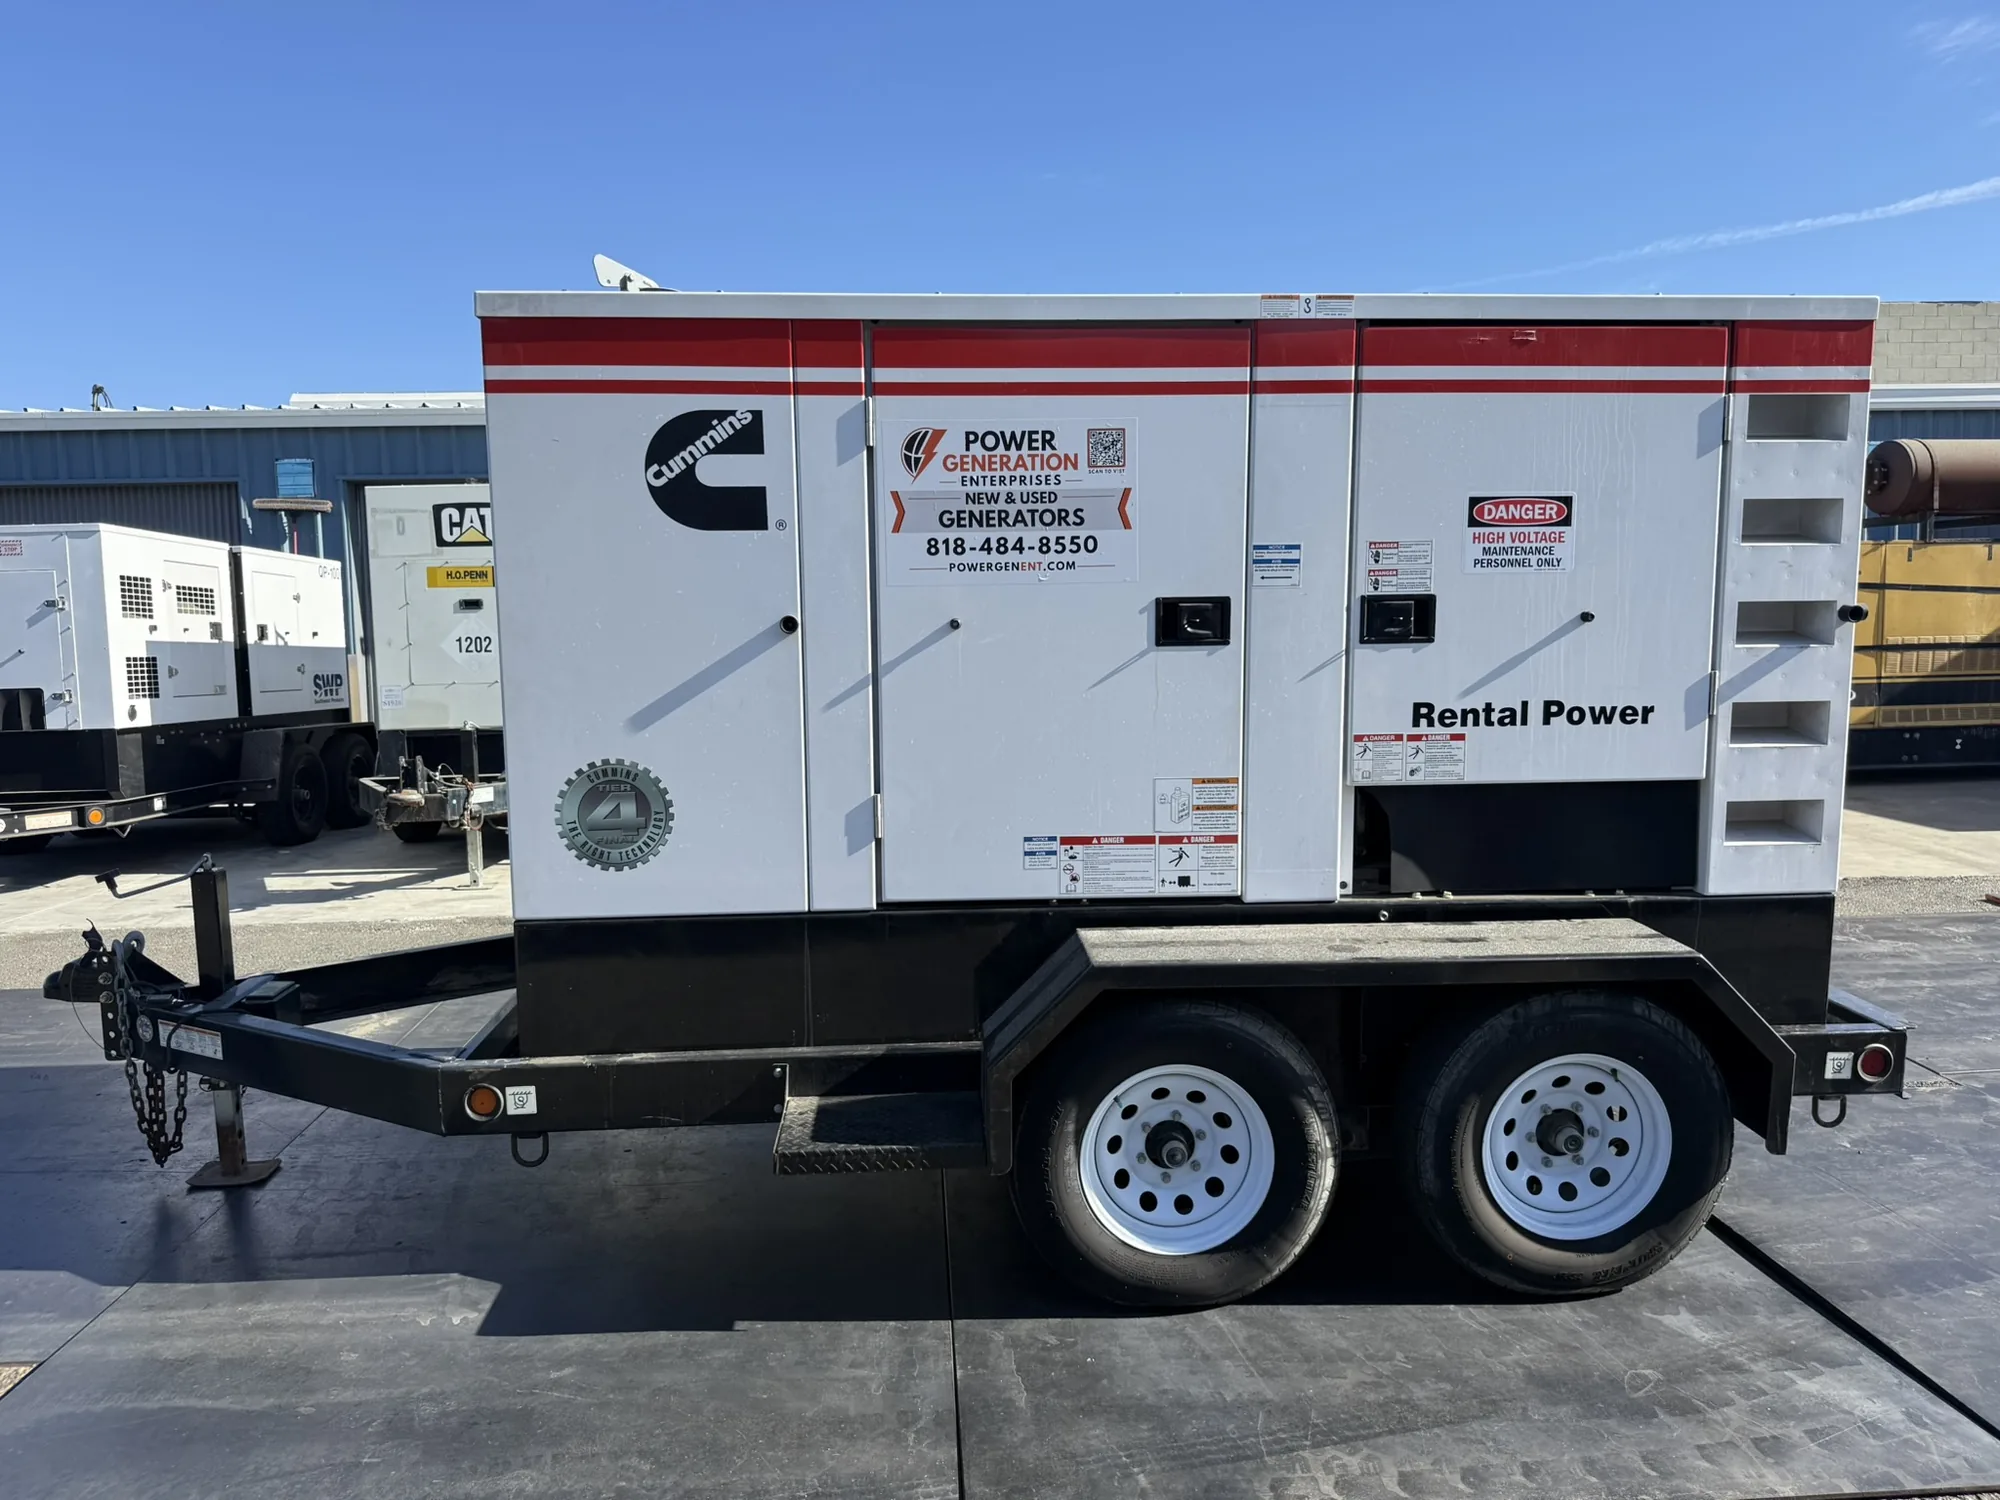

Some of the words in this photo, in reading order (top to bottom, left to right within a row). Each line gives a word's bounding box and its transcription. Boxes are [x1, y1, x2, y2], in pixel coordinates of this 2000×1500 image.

[646, 410, 753, 487] Cummins
[964, 430, 1058, 452] POWER
[942, 453, 1079, 473] GENERATION
[960, 474, 1062, 487] ENTERPRISES
[965, 492, 1001, 505] NEW
[1004, 491, 1017, 505] &
[1020, 491, 1058, 505] USED
[938, 508, 1086, 529] GENERATORS
[1483, 503, 1559, 520] DANGER
[441, 507, 493, 543] CAT
[926, 535, 1099, 556] 818-484-8550
[1472, 531, 1506, 545] HIGH
[1509, 530, 1567, 545] VOLTAGE
[1481, 545, 1556, 557] MAINTENANCE
[949, 561, 1077, 573] POWERGENENT.COM
[1473, 558, 1534, 569] PERSONNEL
[1536, 557, 1563, 568] ONLY
[455, 636, 493, 653] 1202
[1411, 700, 1529, 729] Rental
[1542, 699, 1655, 726] Power
[586, 767, 639, 783] CUMMINS
[596, 784, 632, 793] TIER
[586, 792, 648, 837] 4
[566, 820, 582, 840] THE
[579, 840, 612, 861] RIGHT
[619, 810, 664, 861] TECHNOLOGY
[1099, 836, 1125, 844] DANGER
